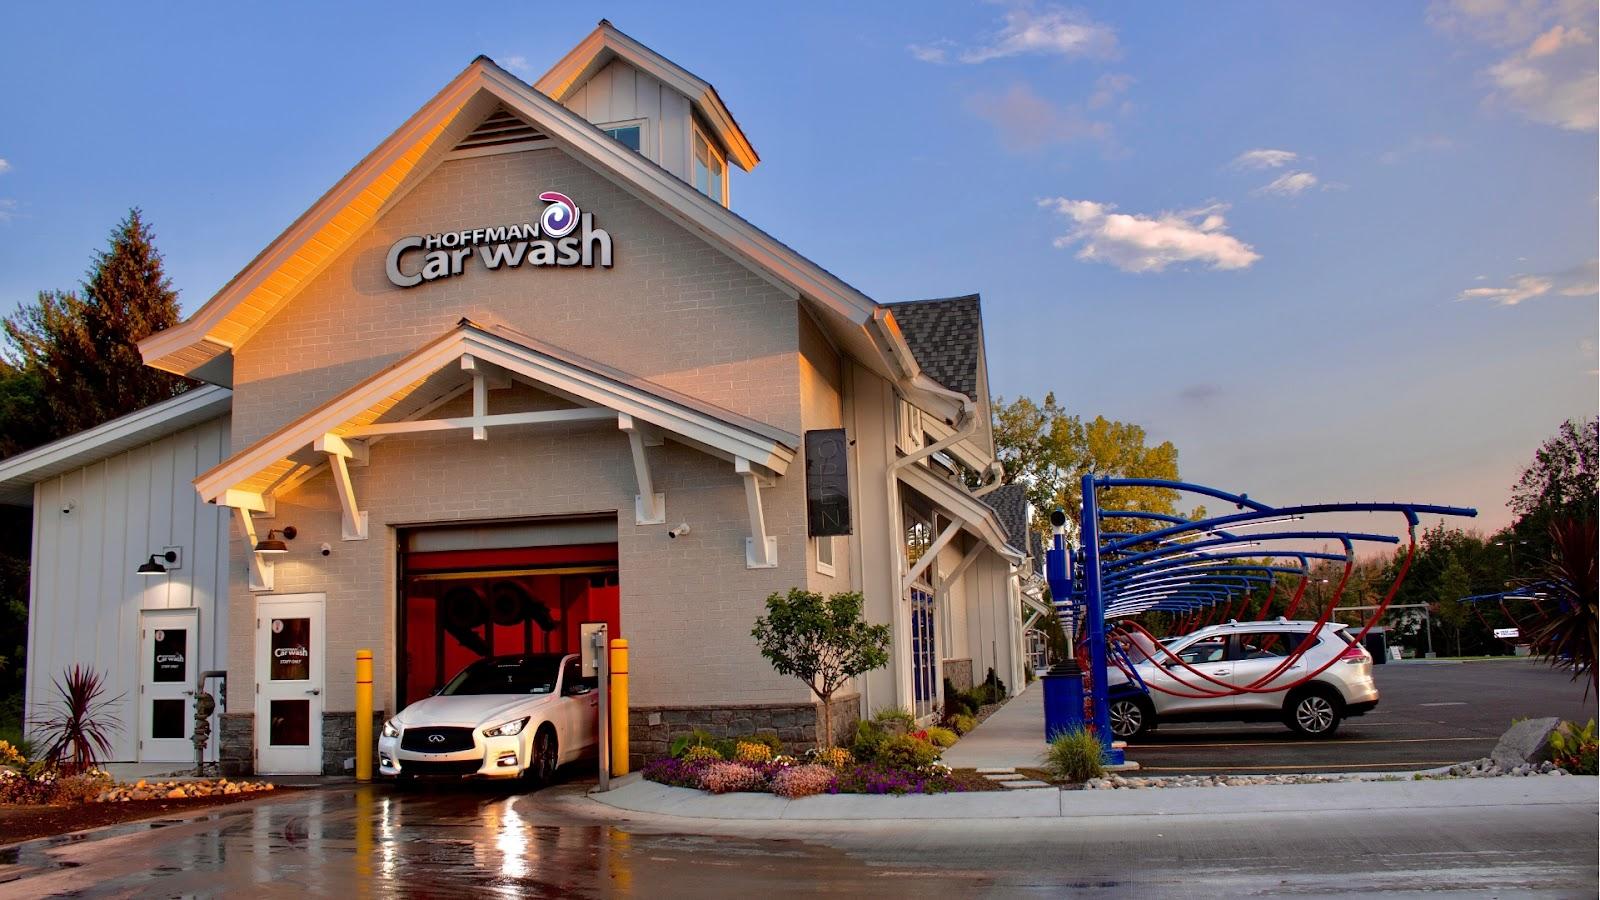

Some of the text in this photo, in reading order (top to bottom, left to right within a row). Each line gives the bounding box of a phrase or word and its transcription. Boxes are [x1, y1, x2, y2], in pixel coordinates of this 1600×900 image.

[385, 212, 612, 287] Car wash
[425, 222, 540, 250] HOFFMAN
[818, 438, 840, 528] OPEN
